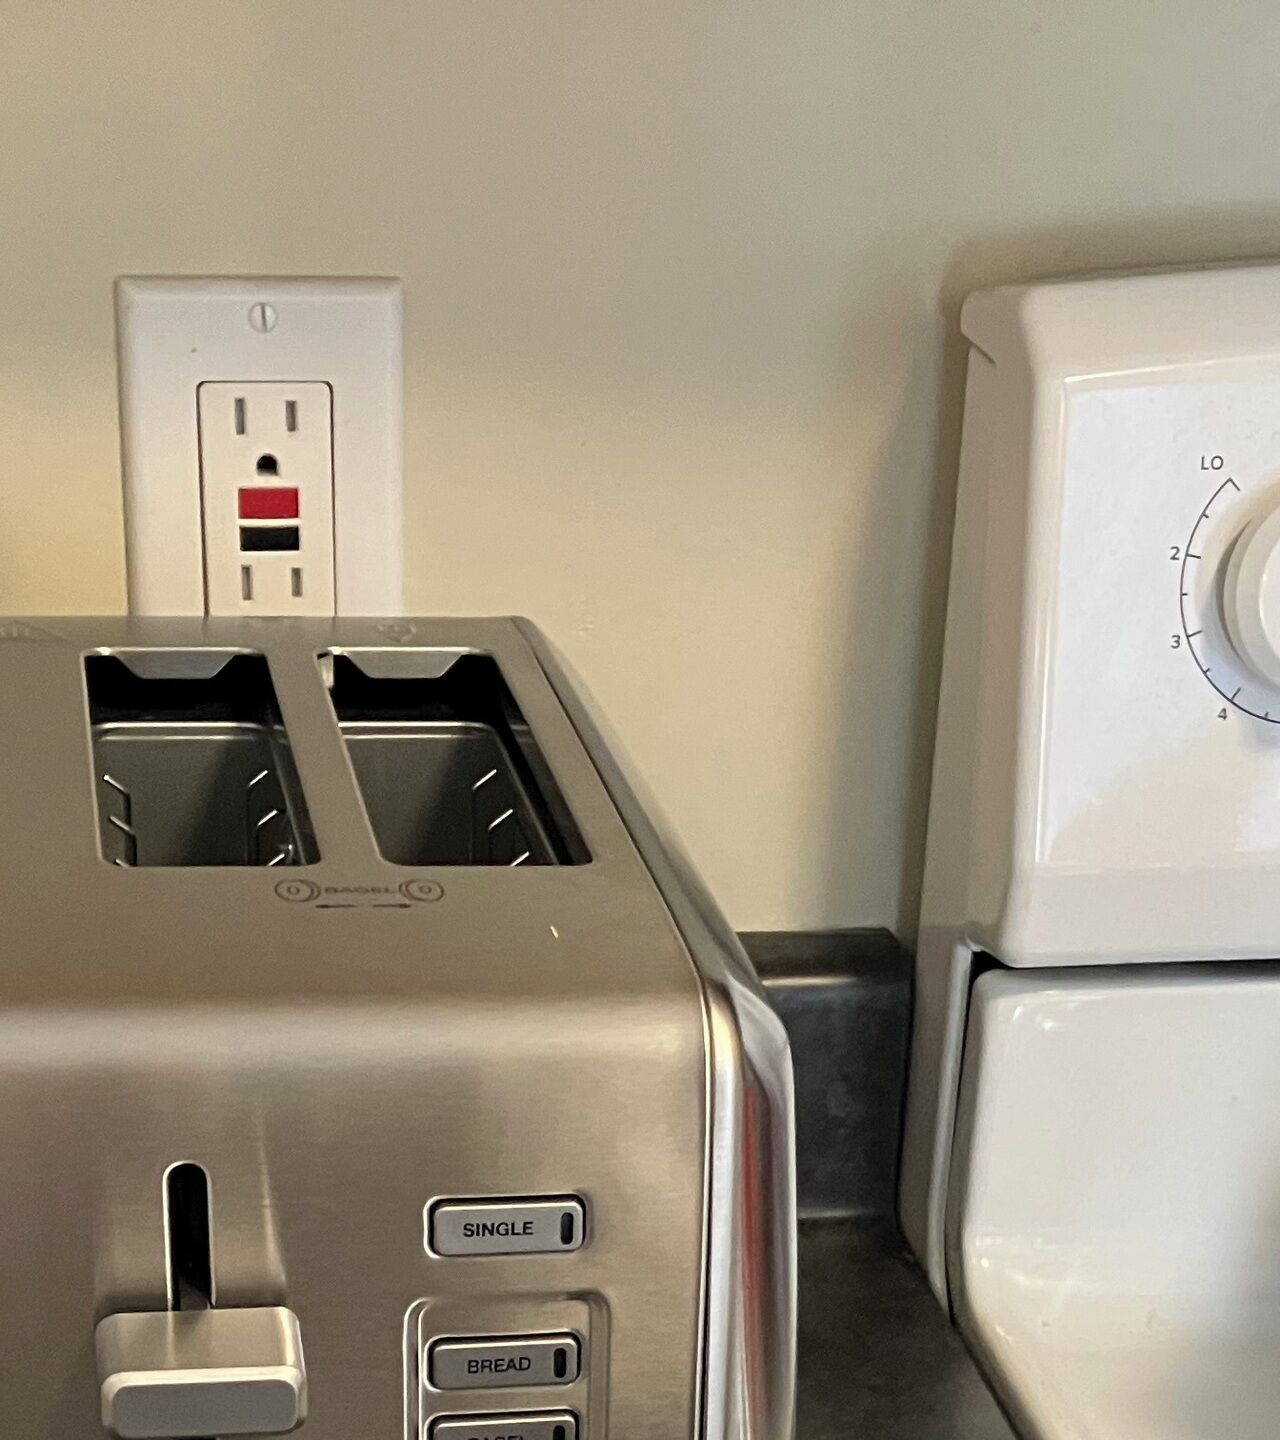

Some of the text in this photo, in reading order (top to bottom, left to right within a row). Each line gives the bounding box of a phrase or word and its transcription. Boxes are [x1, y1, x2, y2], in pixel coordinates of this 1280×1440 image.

[1200, 454, 1224, 471] LO
[1169, 546, 1180, 561] 2
[1170, 634, 1181, 649] 3
[1217, 706, 1229, 721] 4
[462, 1221, 534, 1238] SINGLE
[467, 1356, 532, 1374] BREAD
